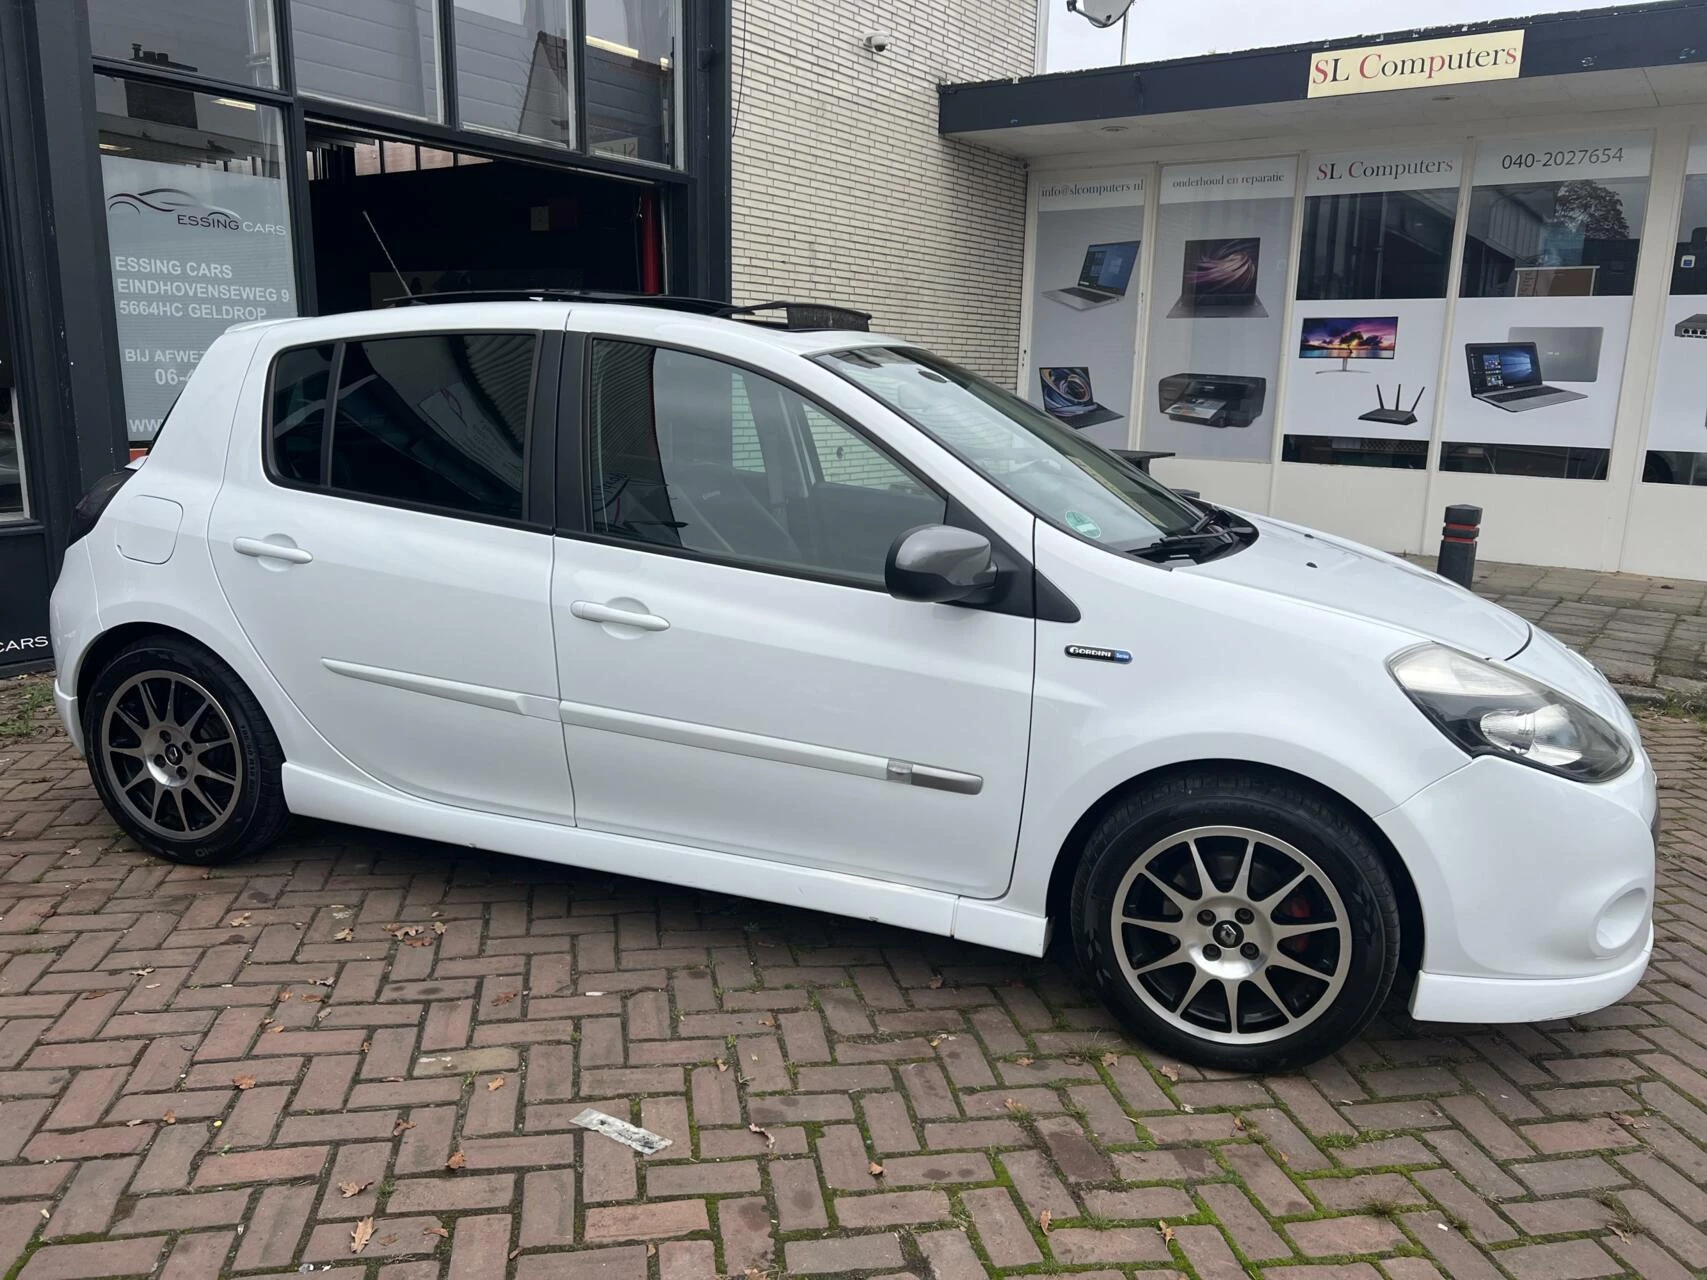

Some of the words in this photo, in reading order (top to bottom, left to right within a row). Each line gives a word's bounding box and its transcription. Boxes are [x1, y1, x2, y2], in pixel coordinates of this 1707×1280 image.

[1312, 59, 1349, 85] SL
[1359, 47, 1517, 79] Computers
[1316, 163, 1342, 181] SL
[1348, 157, 1454, 180] Computers
[1501, 147, 1624, 170] 040-2027654
[1040, 178, 1144, 198] info@slcomputersnl
[1172, 174, 1224, 188] onderhoud
[1226, 177, 1239, 185] en
[1241, 171, 1285, 184] reparatie
[176, 214, 240, 231] ESSING
[242, 221, 287, 236] CARS
[115, 256, 181, 274] ESSING
[186, 262, 233, 278] CARS
[117, 279, 277, 301] EINDHOVENSEWEG
[280, 289, 290, 302] 9
[119, 300, 184, 317] 5664HC
[188, 304, 267, 320] GELDROP
[125, 348, 149, 362] BIJ
[154, 350, 206, 363] AFWE
